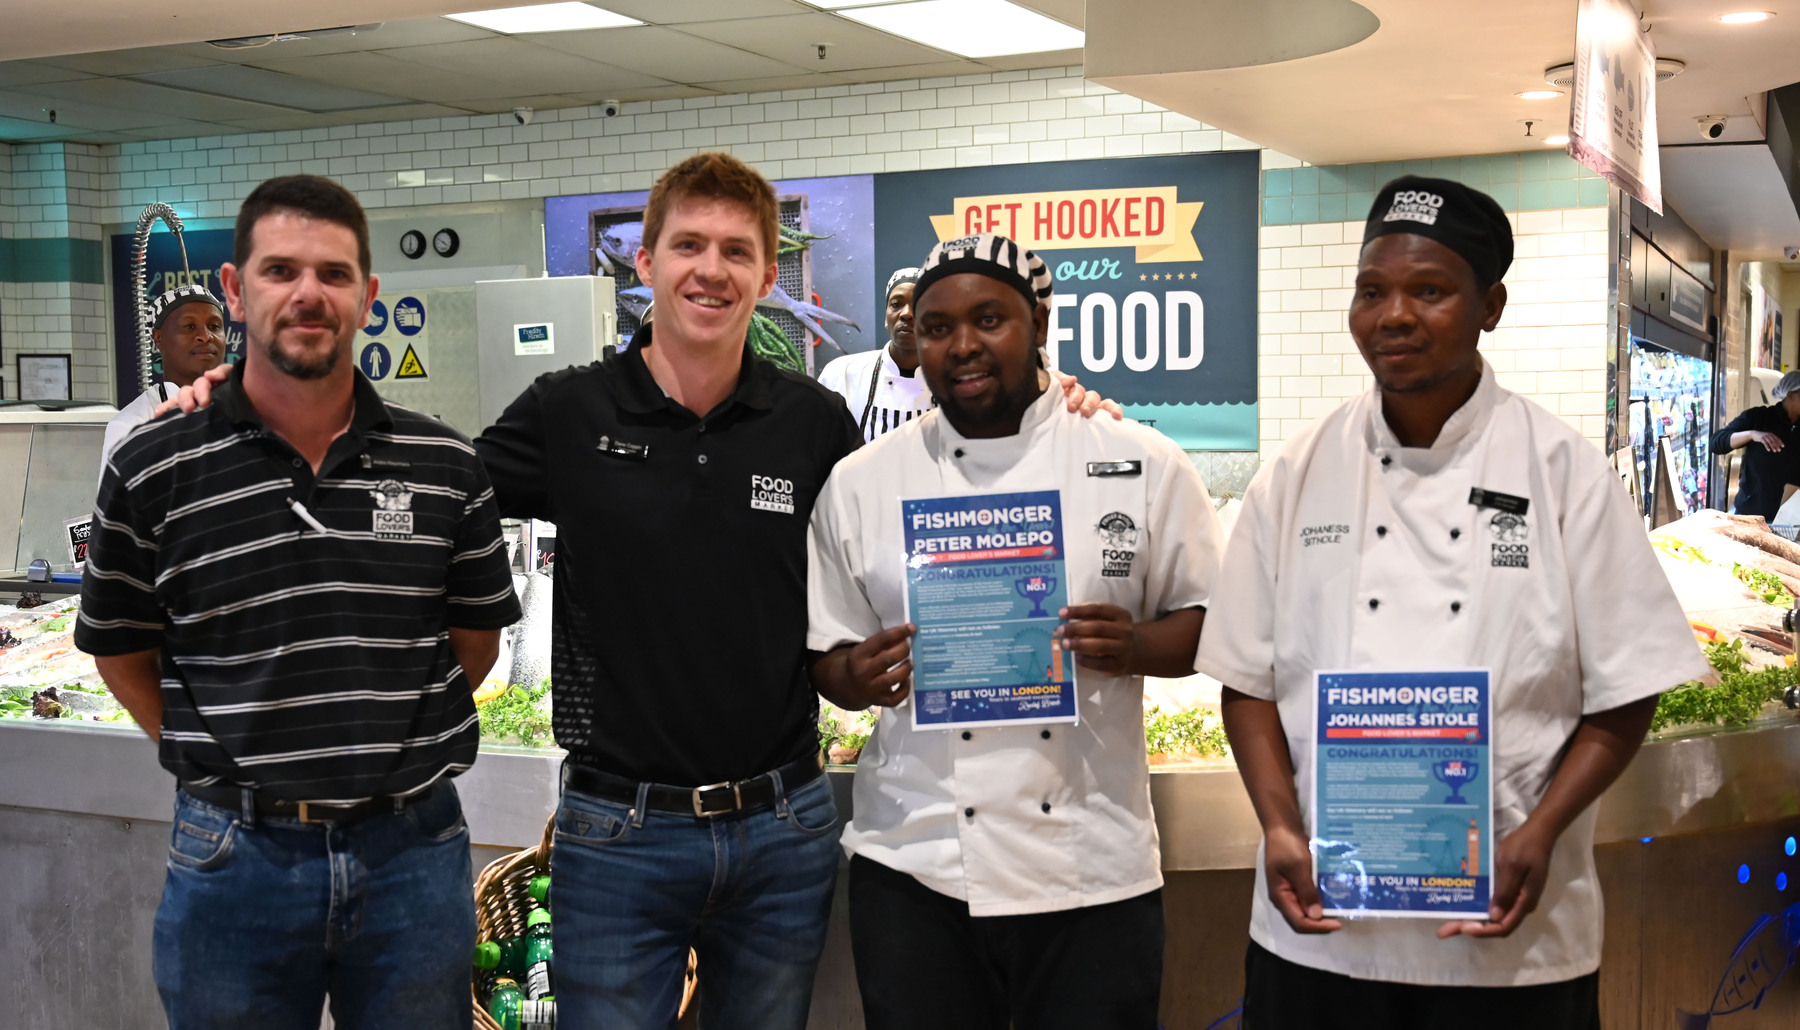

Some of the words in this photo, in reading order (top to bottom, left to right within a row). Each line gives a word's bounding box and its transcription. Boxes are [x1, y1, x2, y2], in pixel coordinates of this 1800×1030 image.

[1393, 190, 1444, 208] FOOD
[964, 203, 1023, 241] GET
[1033, 196, 1165, 241] HOOKED
[1055, 257, 1122, 281] our
[752, 474, 794, 494] FOOD
[376, 513, 411, 524] FOOD
[912, 505, 1053, 530] FISHMONGER
[914, 537, 972, 553] PETER
[976, 531, 1054, 549] MOLEPO
[1492, 544, 1529, 554] FOOD
[1102, 549, 1135, 561] FOOD
[917, 563, 1056, 582] CONGRATULATIONS!
[950, 690, 971, 700] SEE
[973, 689, 997, 699] YOU
[998, 687, 1010, 697] IN
[1011, 685, 1062, 696] LONDON!
[1328, 687, 1479, 705] FISHMONGER
[1327, 714, 1416, 727] JOHANNES
[1419, 713, 1479, 726] SITOLE
[1327, 747, 1478, 759] CONGRATULATIONS!
[1378, 876, 1404, 886] YOU
[1406, 876, 1419, 886] IN
[1421, 878, 1477, 888] LONDON!
